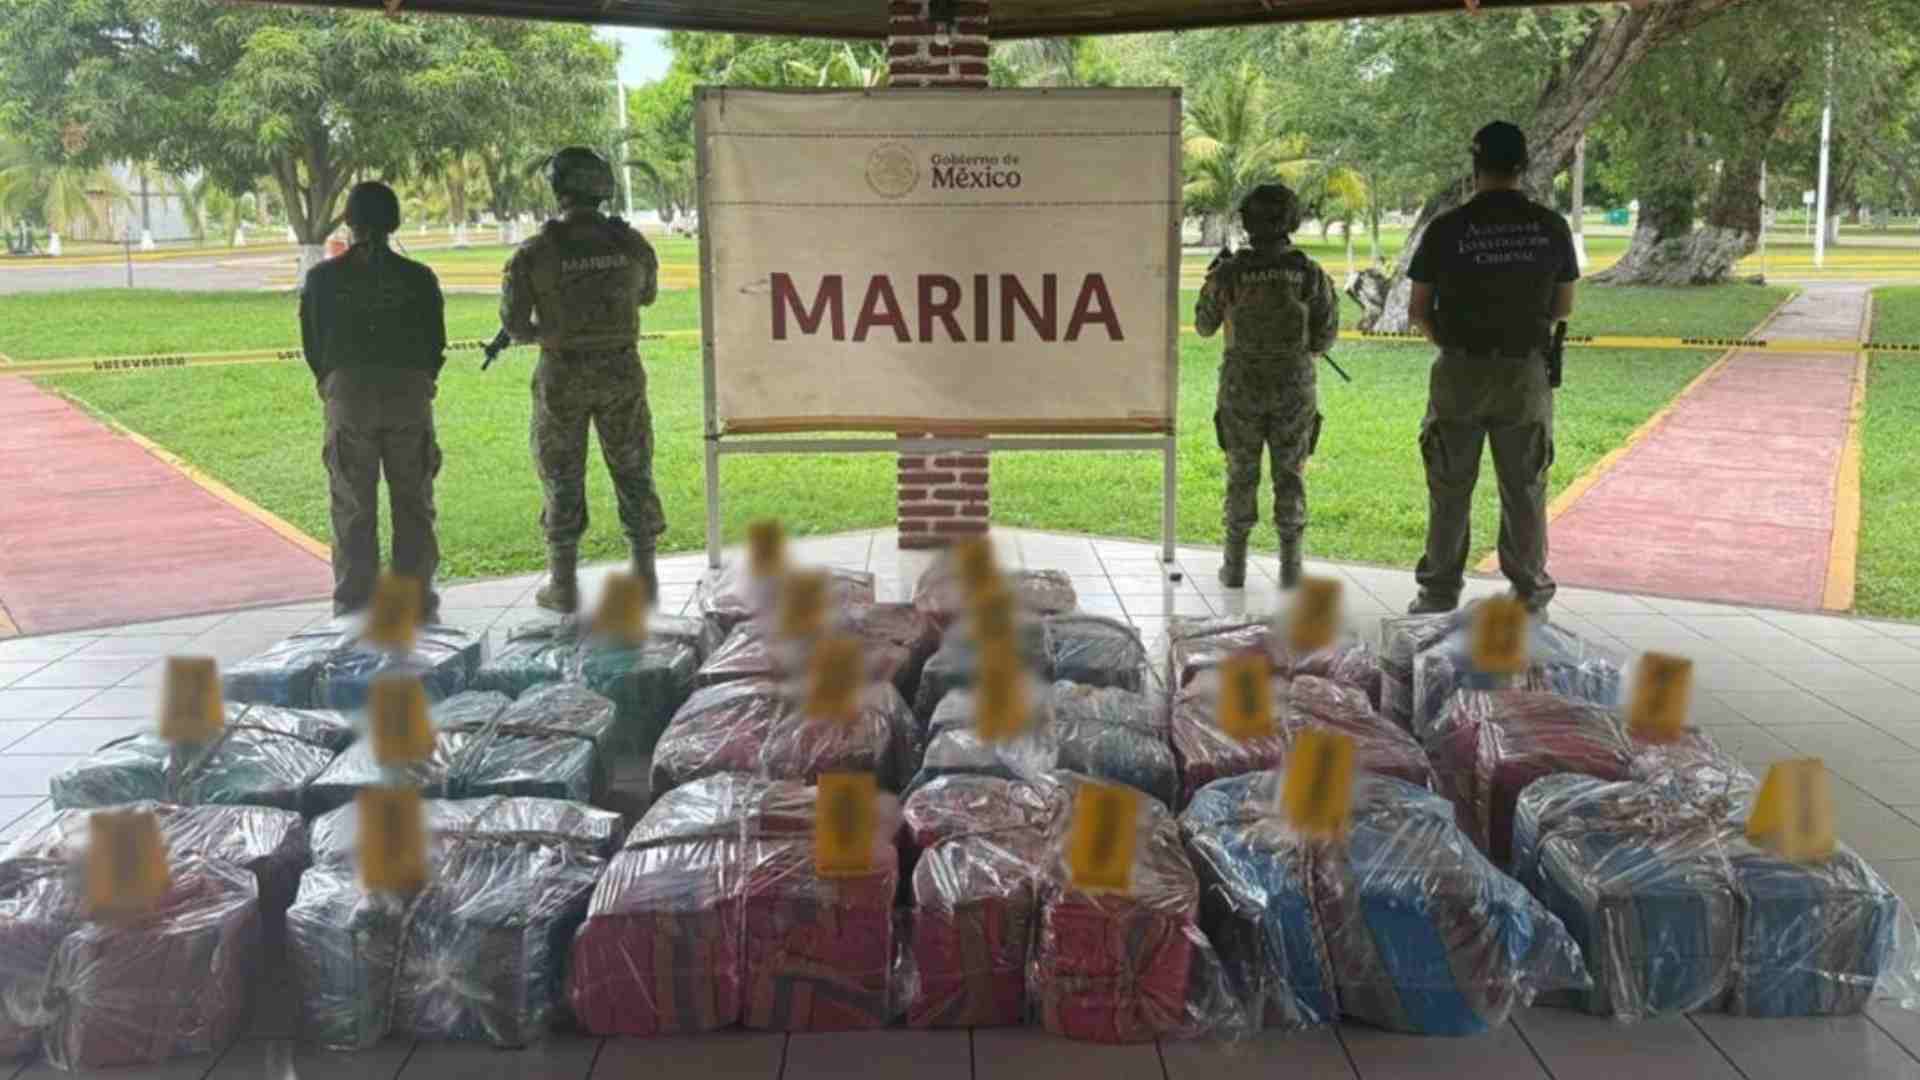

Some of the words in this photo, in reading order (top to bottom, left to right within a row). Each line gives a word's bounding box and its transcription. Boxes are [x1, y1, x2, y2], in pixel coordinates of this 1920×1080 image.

[931, 153, 999, 165] Gobierno
[1003, 153, 1020, 165] de
[931, 166, 1022, 189] México
[561, 254, 631, 272] MARINA
[770, 272, 1125, 343] MARINA
